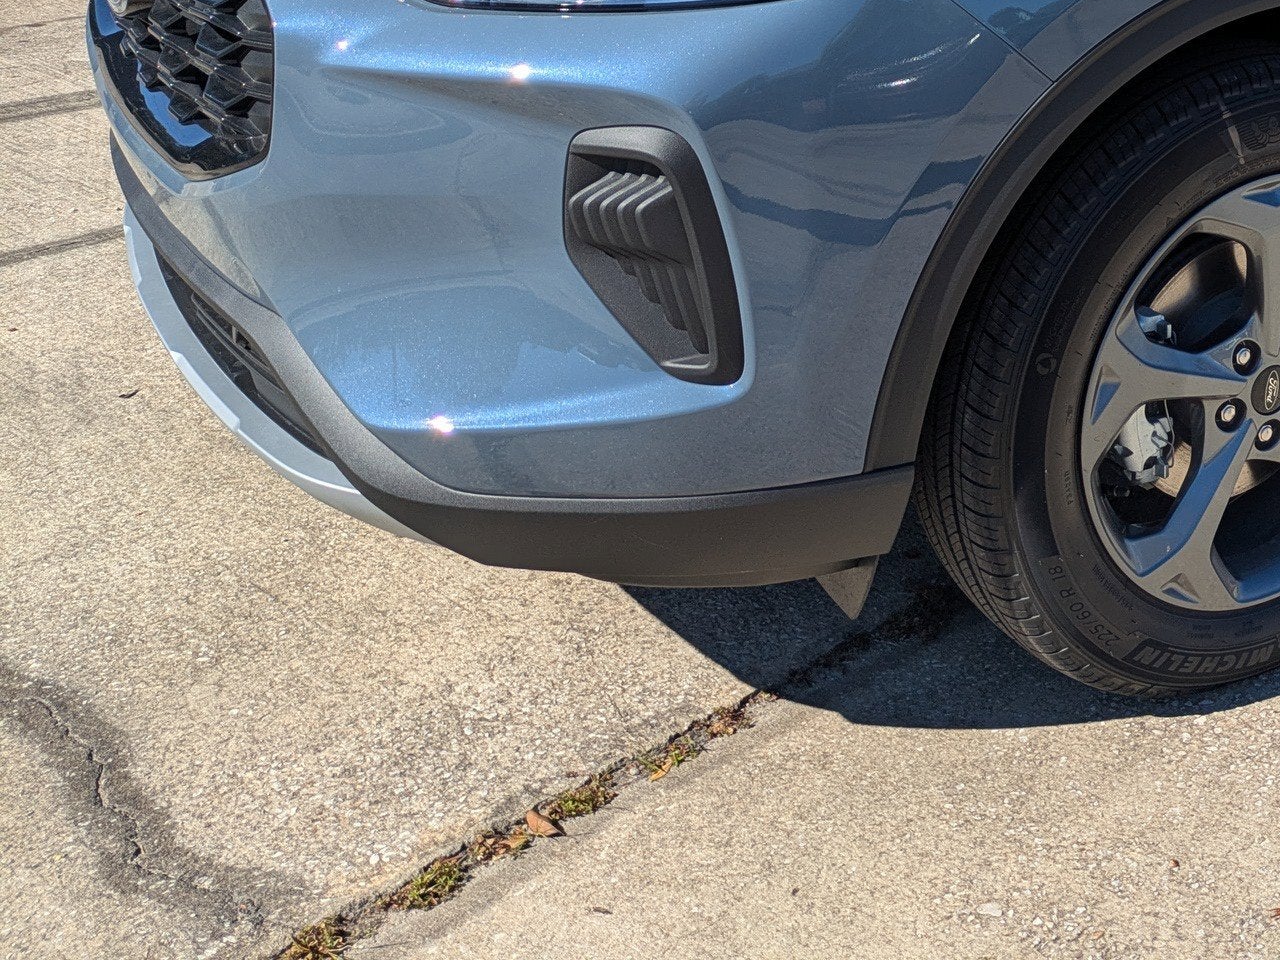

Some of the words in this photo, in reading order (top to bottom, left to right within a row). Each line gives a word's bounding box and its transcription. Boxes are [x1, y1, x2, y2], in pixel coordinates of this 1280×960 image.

[1265, 377, 1278, 404] Ford
[1048, 566, 1065, 582] 18
[1068, 601, 1121, 647] 225/60
[1132, 644, 1276, 674] MICHELIN
